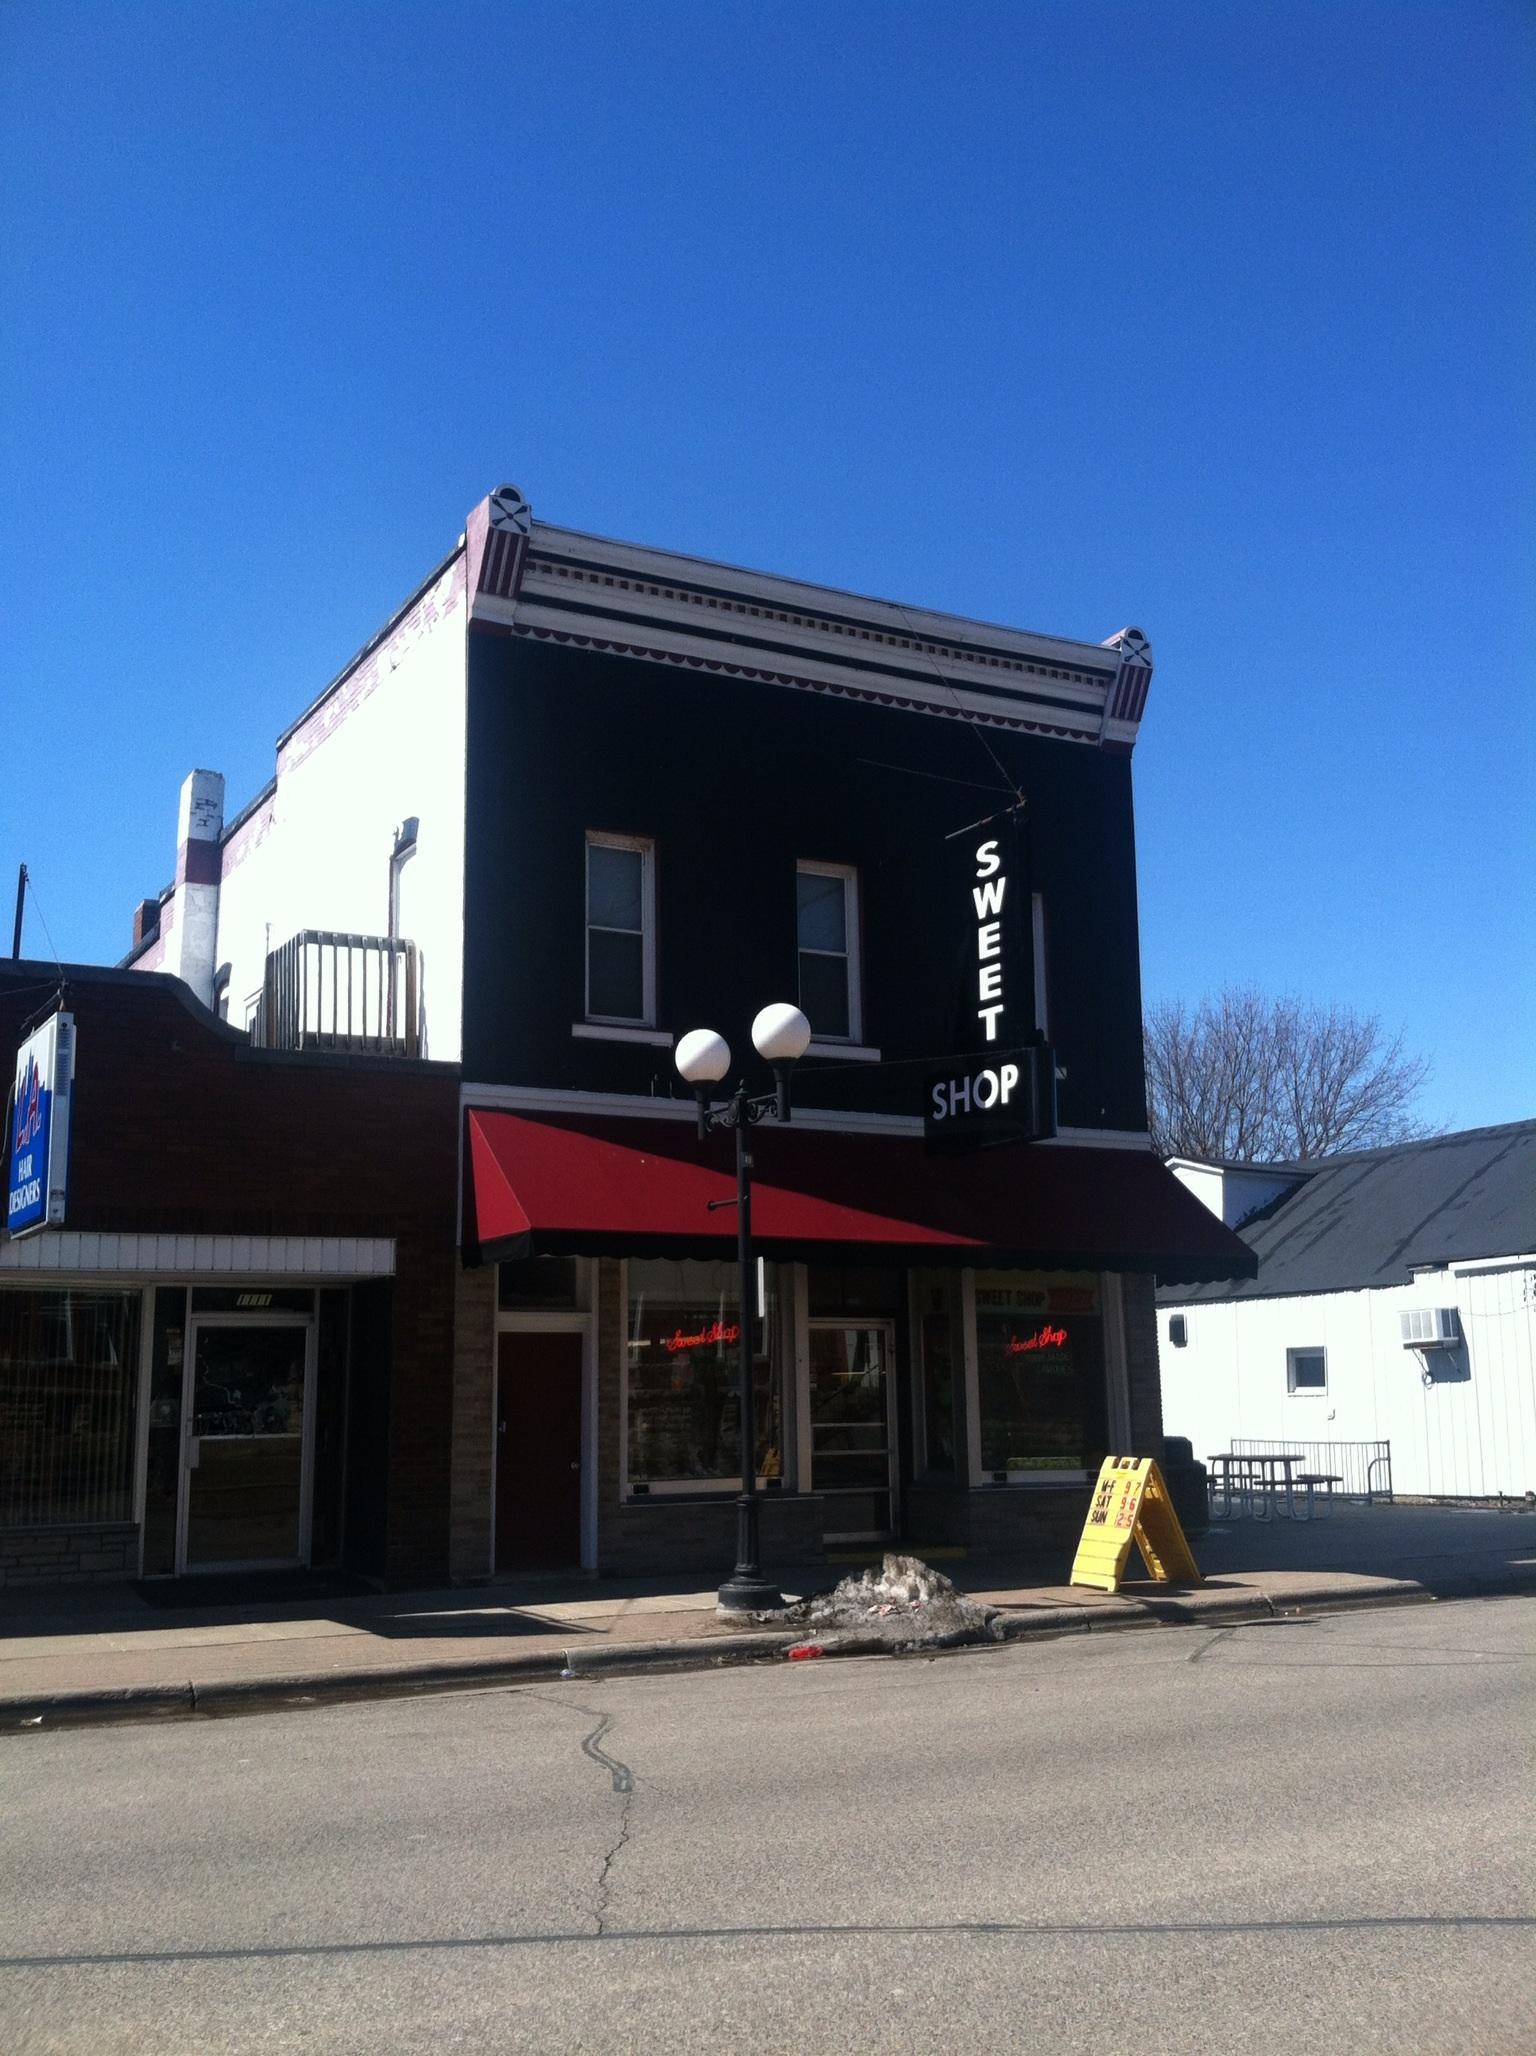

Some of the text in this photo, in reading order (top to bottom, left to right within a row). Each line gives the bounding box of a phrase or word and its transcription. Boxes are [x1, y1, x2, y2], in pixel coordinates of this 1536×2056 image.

[972, 840, 1006, 1041] SWEET
[932, 1064, 1019, 1120] SHOP
[18, 1154, 33, 1182] HAIR
[9, 1180, 40, 1215] DESIGNERS
[706, 1321, 740, 1344] Shop
[1038, 1325, 1068, 1347] Shop
[1095, 1495, 1112, 1508] SAT
[1091, 1510, 1108, 1524] SUN
